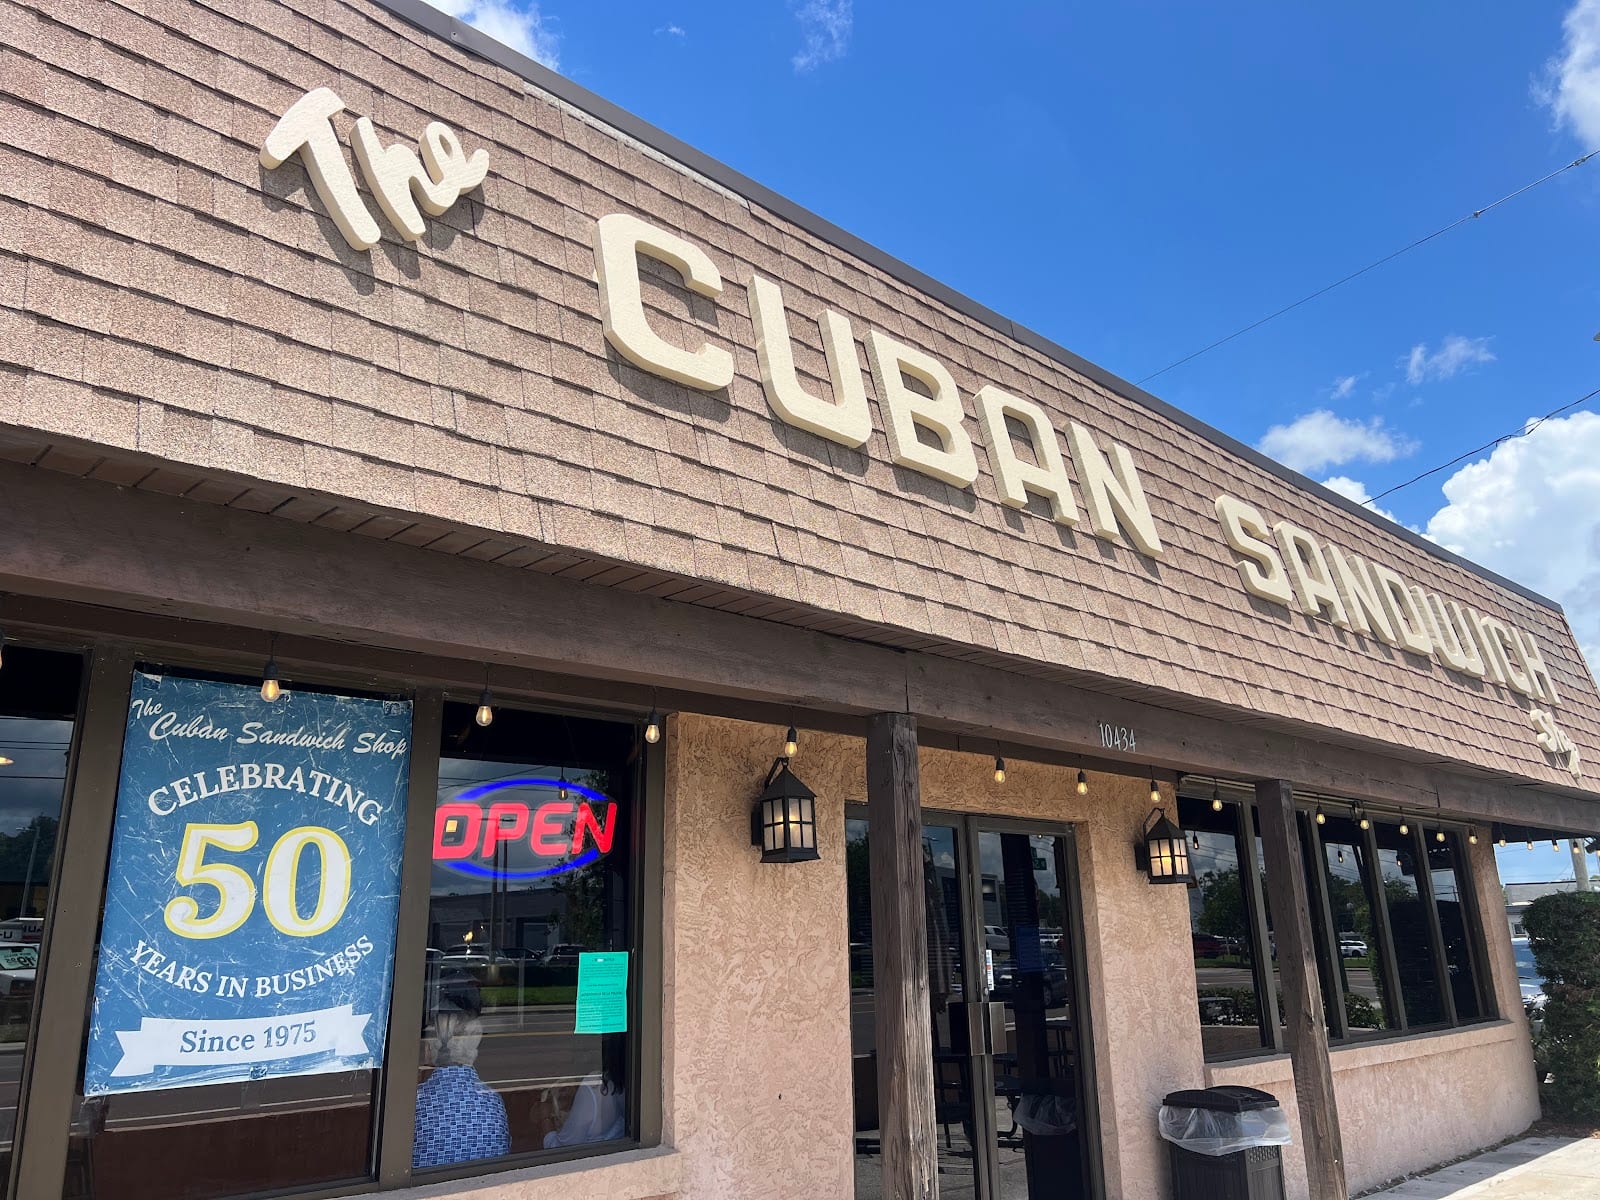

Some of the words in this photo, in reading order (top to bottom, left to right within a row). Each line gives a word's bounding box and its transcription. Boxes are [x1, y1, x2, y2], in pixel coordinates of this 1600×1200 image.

[259, 87, 490, 251] The
[593, 213, 1165, 557] CUBAN
[1215, 495, 1561, 706] SANDWICH
[131, 698, 163, 720] The
[149, 712, 228, 741] Cuban
[236, 722, 346, 751] Sandwich
[352, 732, 408, 761] Shop
[1099, 722, 1136, 753] 10434
[148, 763, 384, 826] CELEBRATING
[432, 802, 618, 860] OPEN
[164, 820, 352, 940] 50
[128, 940, 213, 993] YEARS
[215, 976, 249, 998] IN
[254, 935, 375, 998] BUSINESS
[179, 1029, 256, 1053] Since
[263, 1020, 318, 1048] 1975
